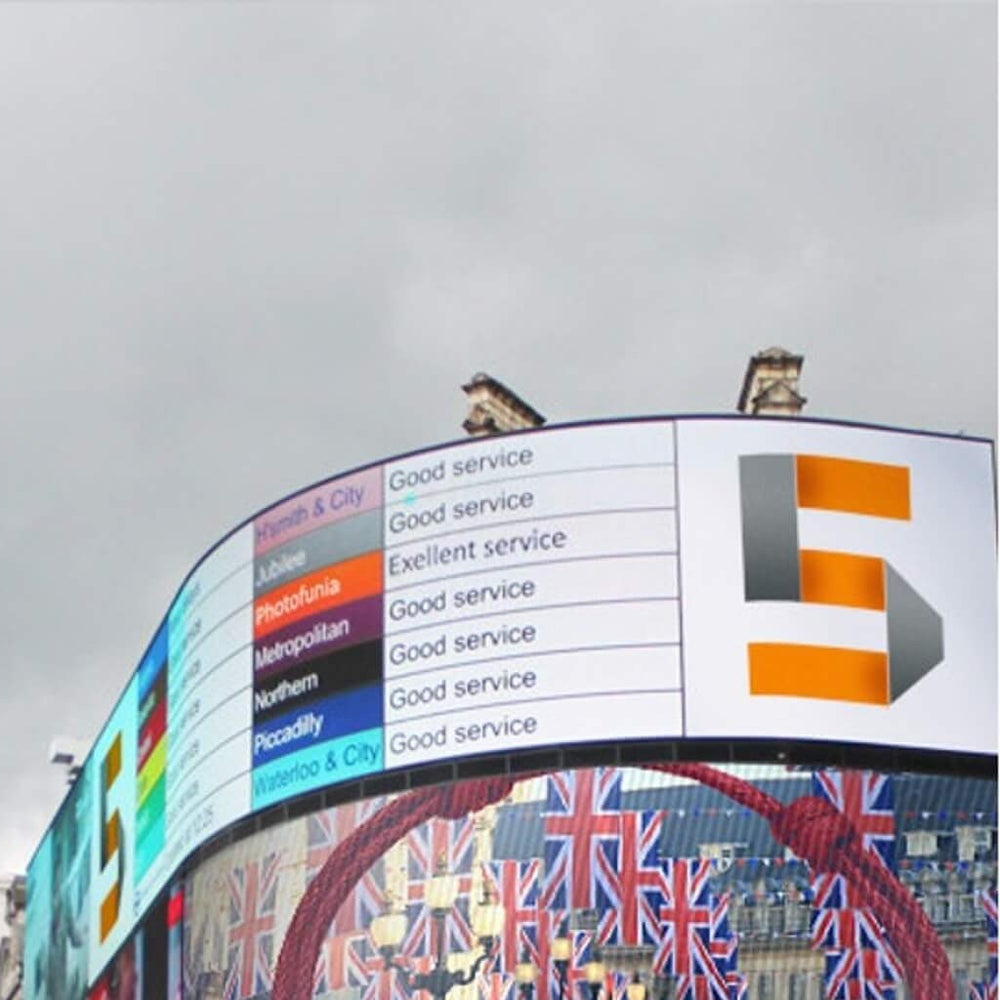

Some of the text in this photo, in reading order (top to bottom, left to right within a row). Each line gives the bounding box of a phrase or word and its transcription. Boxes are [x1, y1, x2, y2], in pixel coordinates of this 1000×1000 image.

[389, 448, 533, 491] Good service
[313, 501, 325, 517] &
[330, 486, 365, 512] City
[389, 491, 534, 534] Good service
[256, 550, 307, 587] Jubilee
[389, 526, 567, 577] Exellent service
[255, 577, 341, 625] Photofunia
[390, 579, 535, 620] Good service
[255, 617, 350, 670] Metropolitan
[390, 625, 536, 666] Good service
[255, 672, 319, 712] Northern
[390, 670, 537, 709] Good service
[255, 713, 323, 755] Piccadilly
[390, 716, 538, 755] Good service
[254, 741, 380, 797] Waterloo & City
